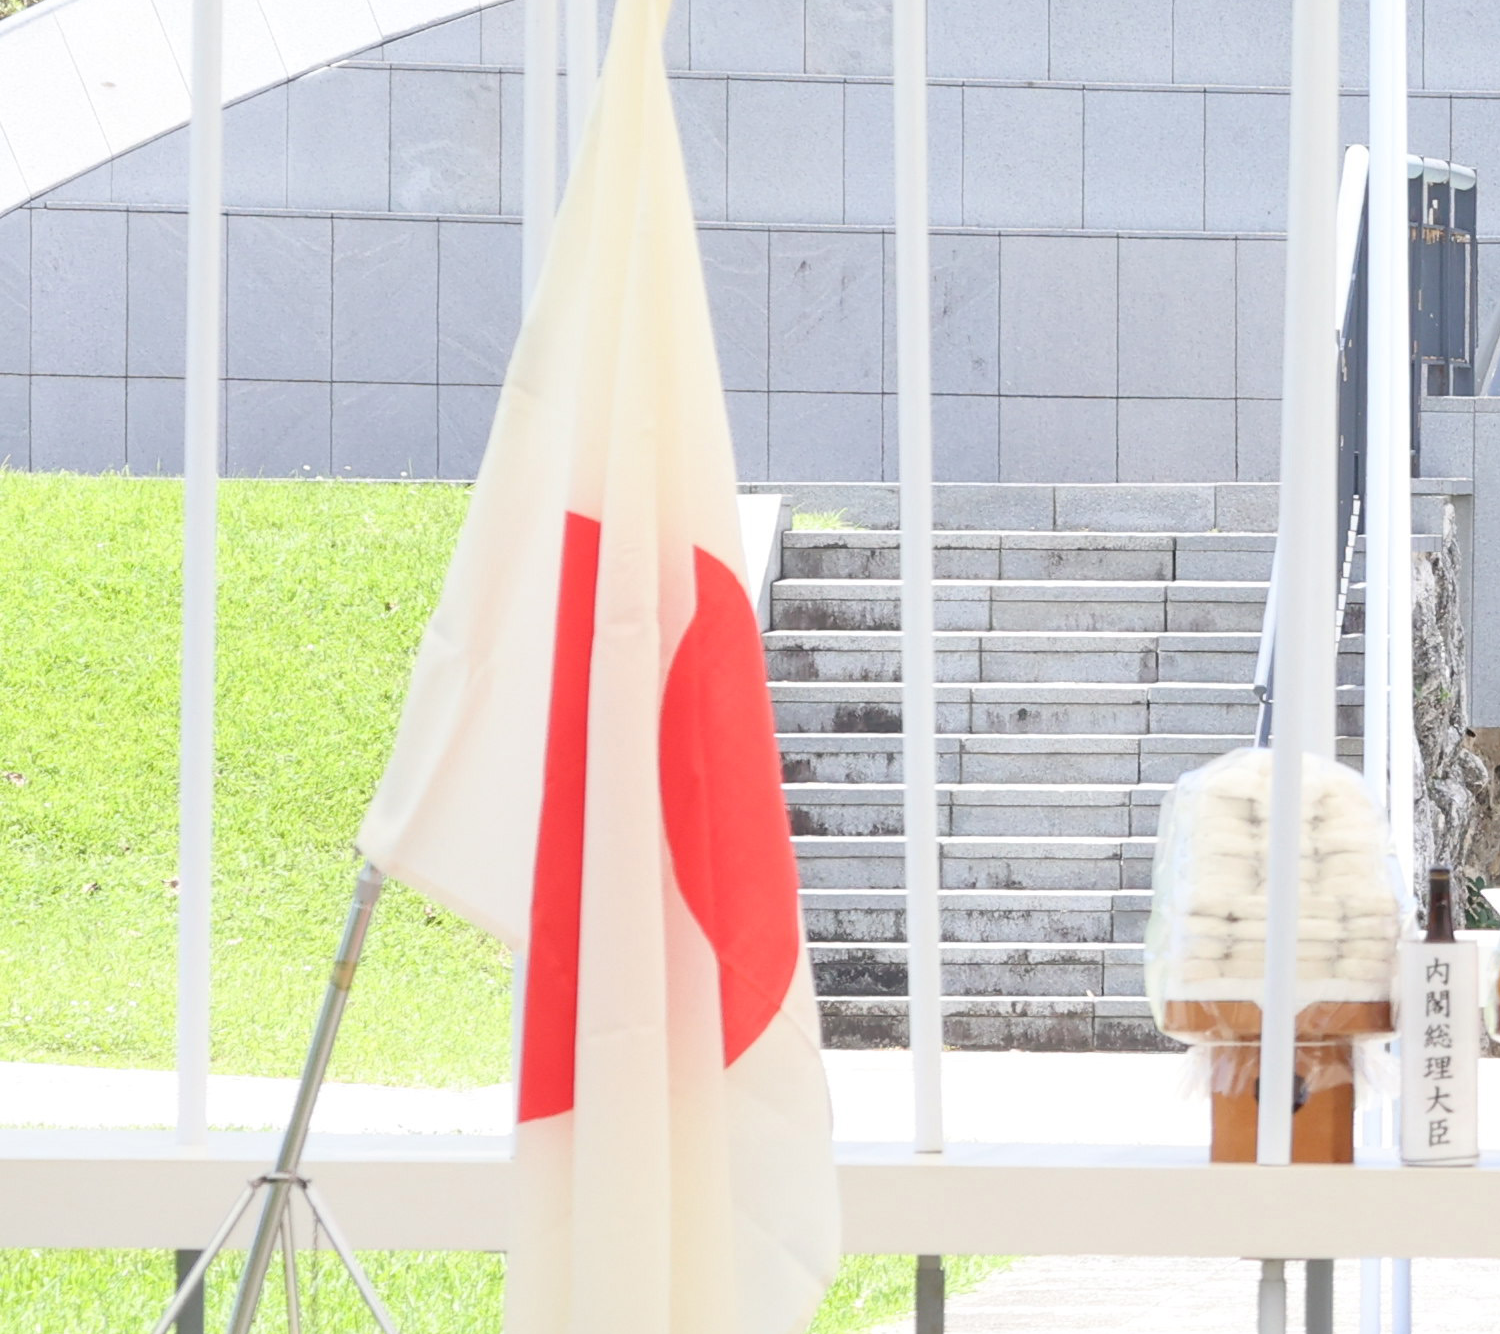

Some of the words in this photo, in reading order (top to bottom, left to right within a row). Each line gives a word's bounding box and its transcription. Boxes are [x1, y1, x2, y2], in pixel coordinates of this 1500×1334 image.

[1422, 957, 1454, 1148] 内閣総理大臣
